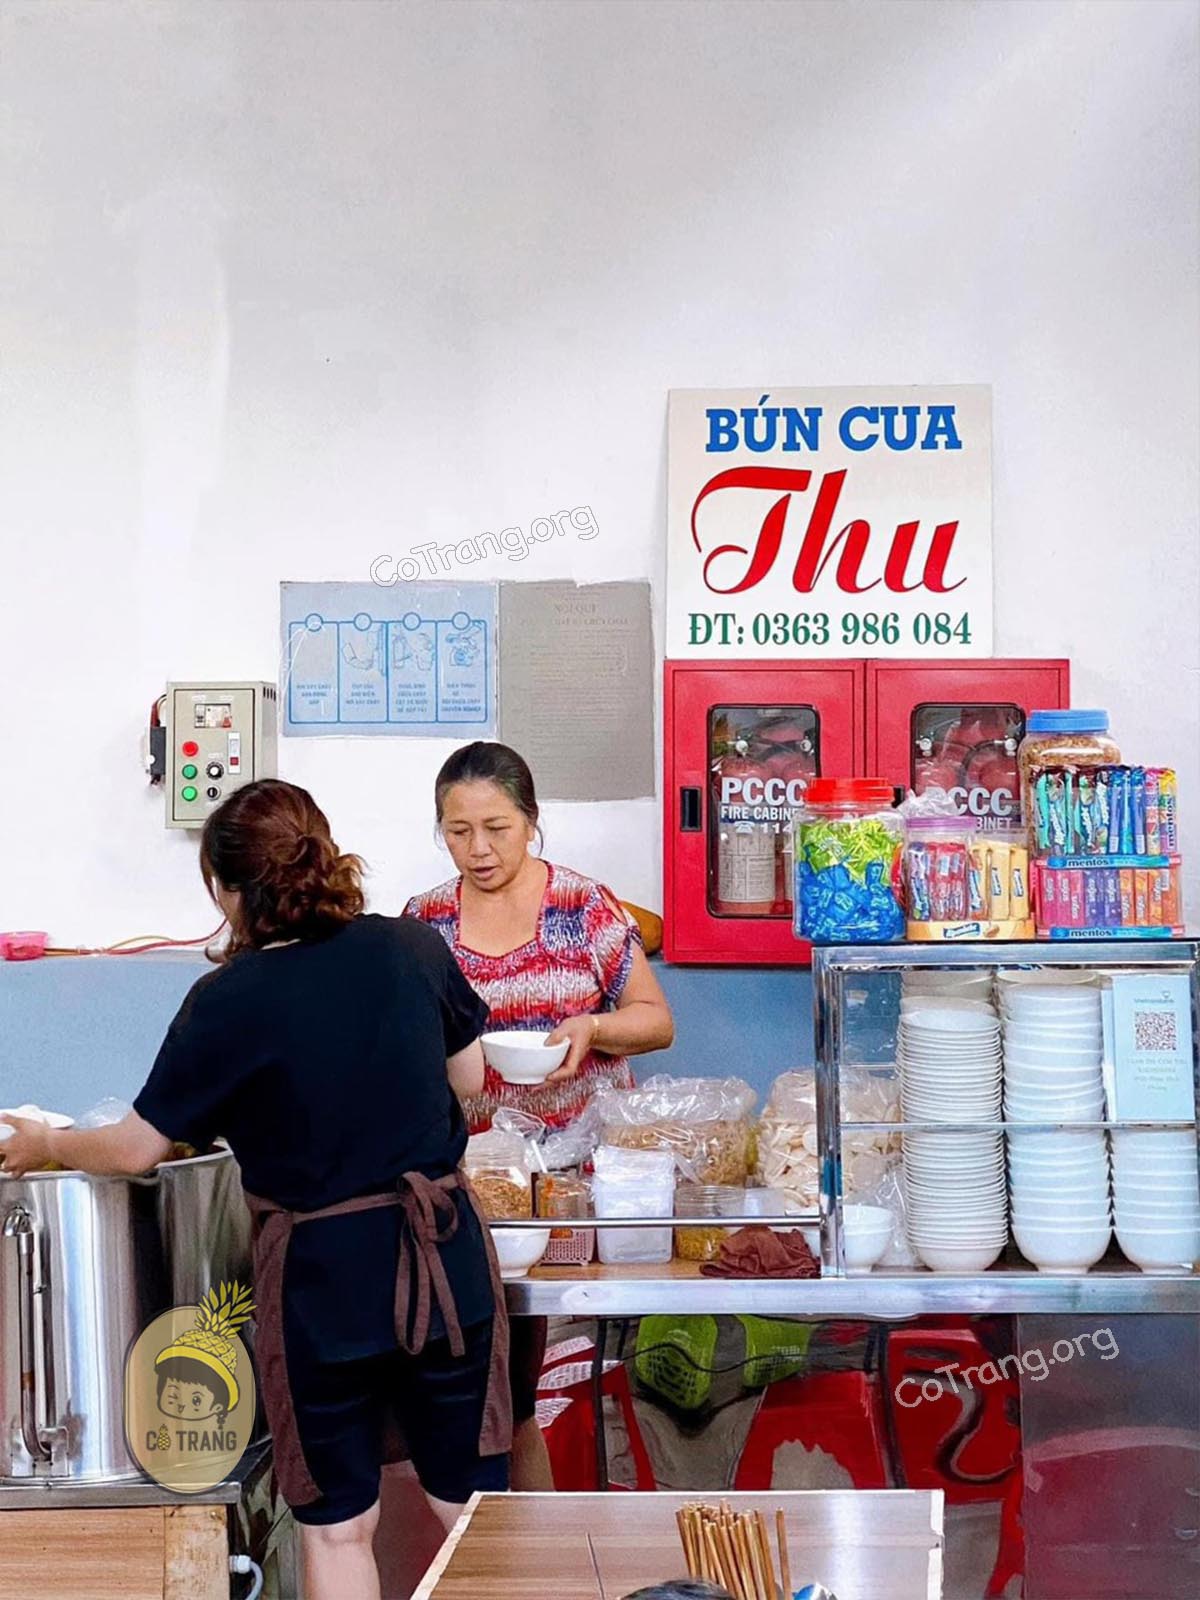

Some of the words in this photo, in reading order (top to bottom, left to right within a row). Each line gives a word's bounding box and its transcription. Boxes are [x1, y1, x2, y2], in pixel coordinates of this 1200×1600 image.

[705, 394, 823, 453] BÚN
[838, 405, 963, 452] CUA
[691, 465, 968, 595] Thu
[688, 613, 744, 645] ĐT:
[752, 612, 830, 645] 0363
[841, 612, 900, 645] 986
[913, 612, 972, 645] 084
[721, 777, 808, 807] PCCC
[947, 786, 1013, 816] CCC
[720, 806, 749, 820] FIRE
[1166, 797, 1175, 847] mentos
[1068, 857, 1109, 867] mentos
[1071, 928, 1112, 938] mentos
